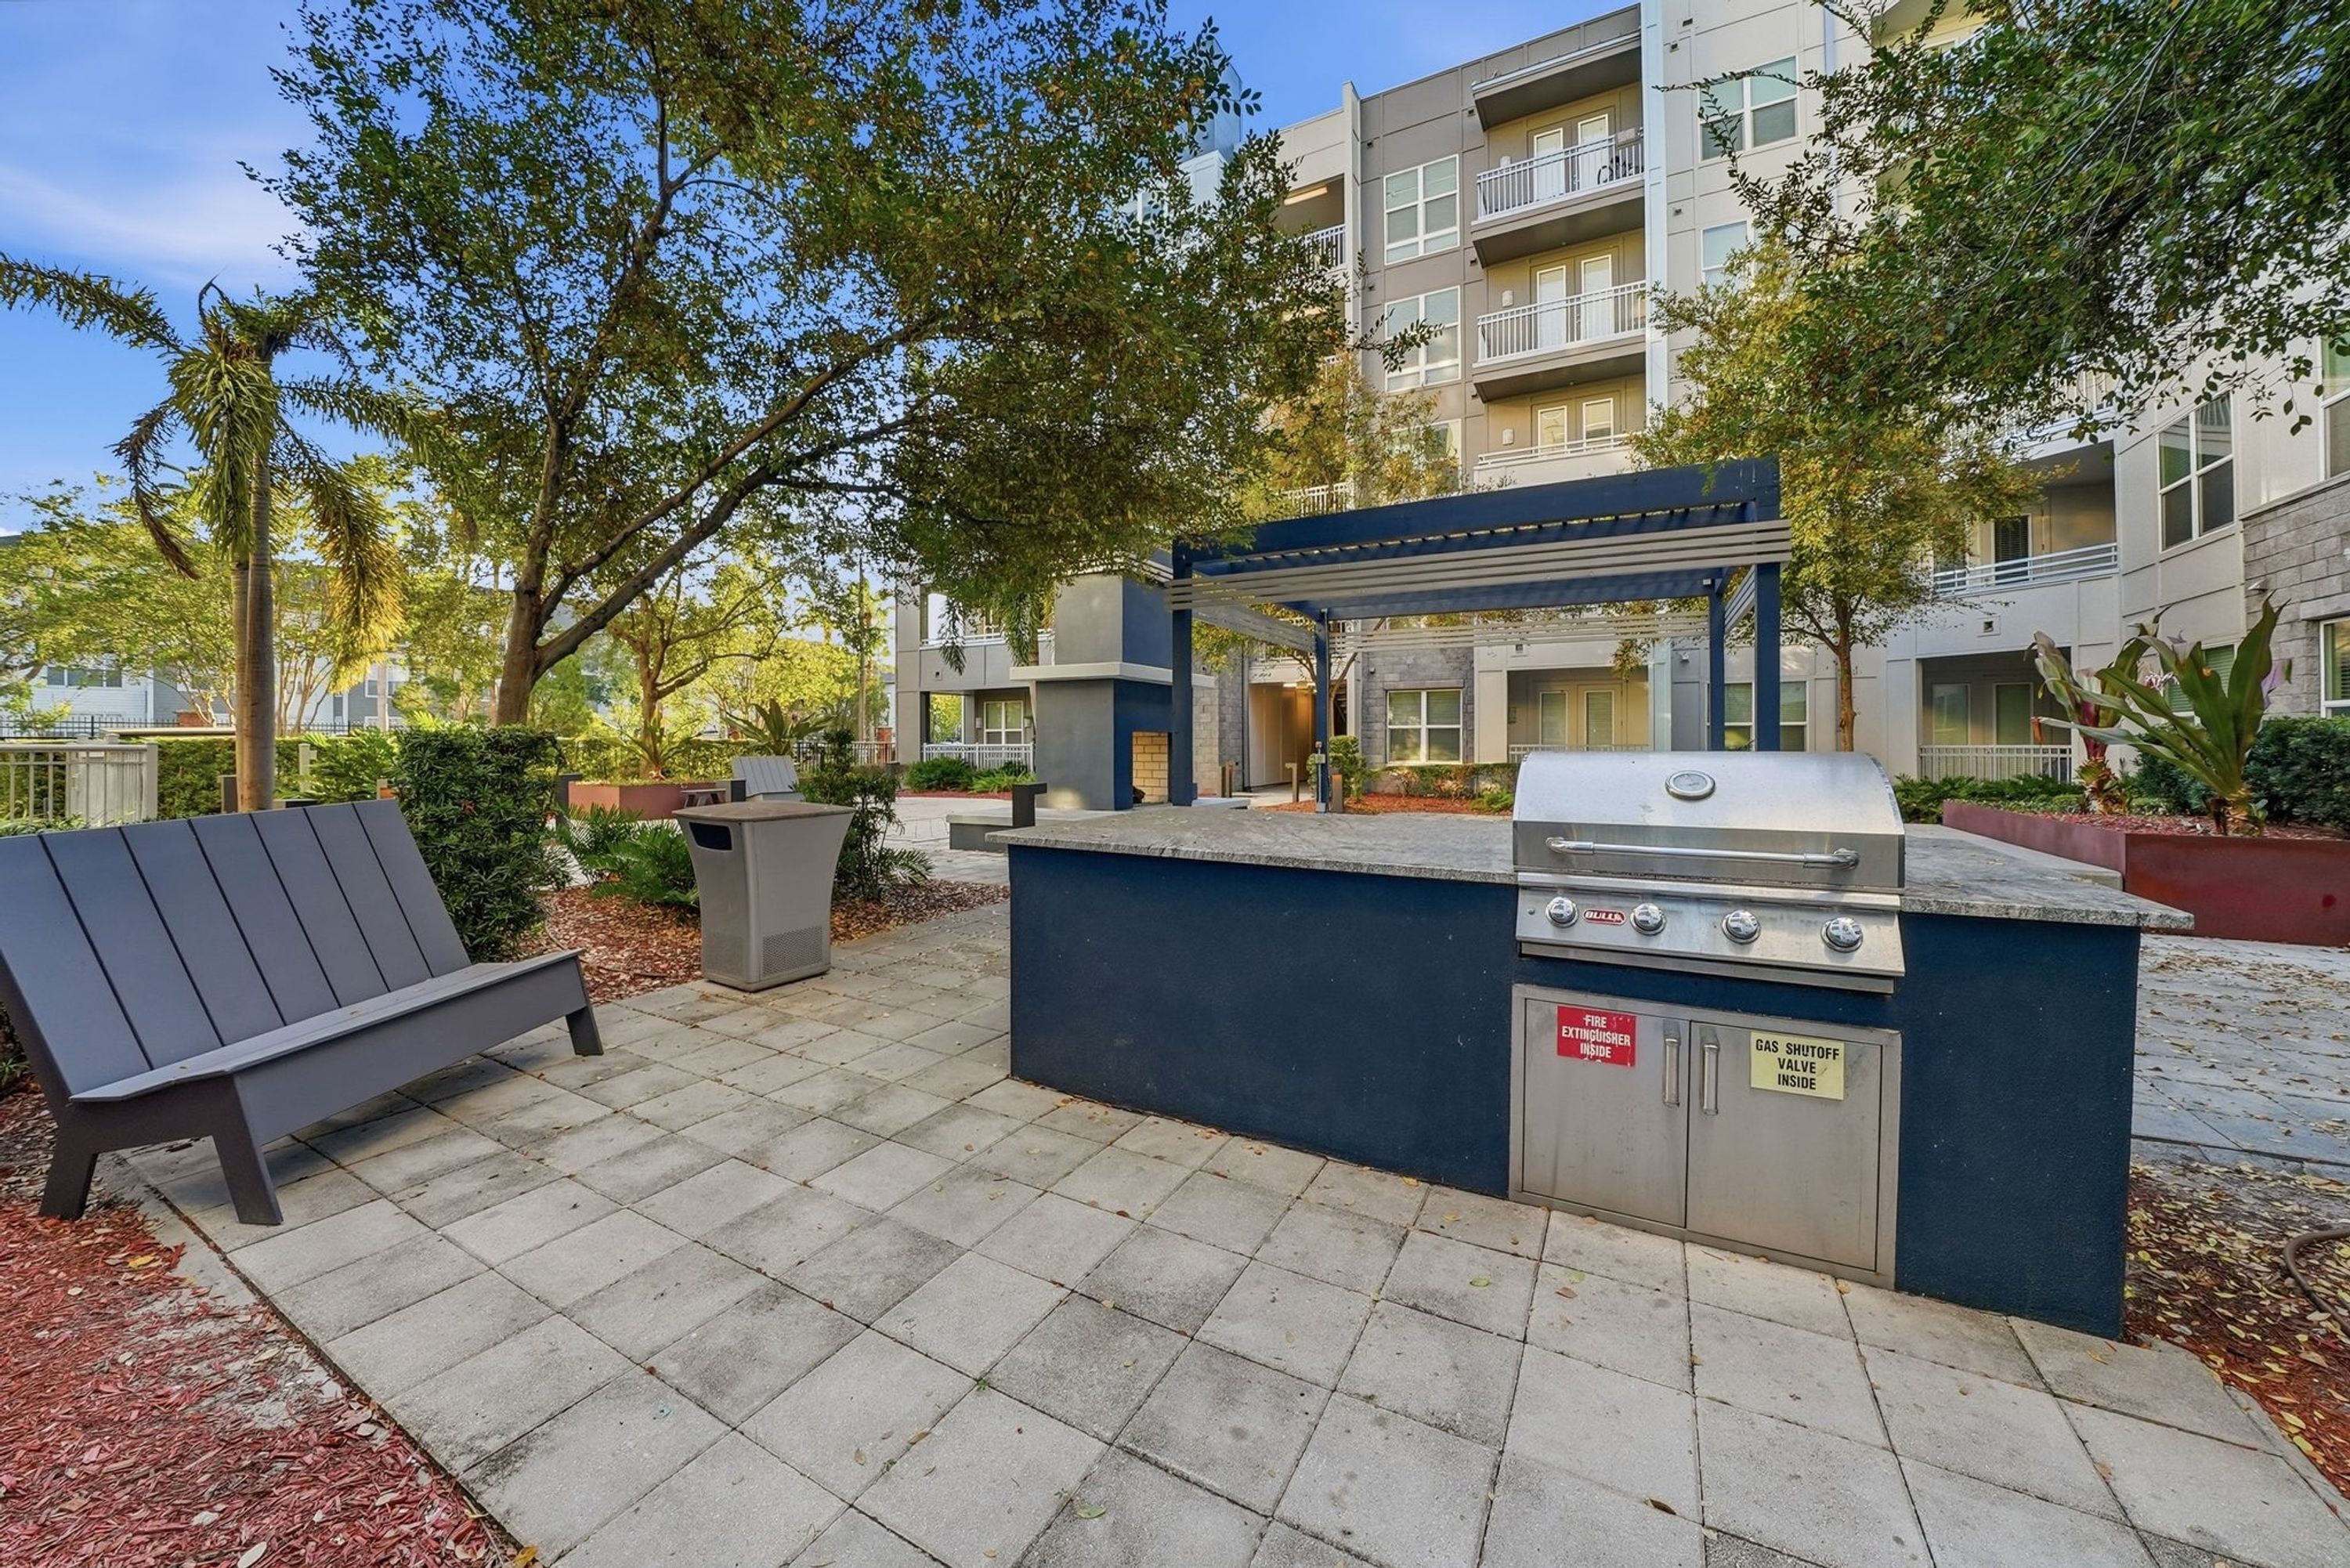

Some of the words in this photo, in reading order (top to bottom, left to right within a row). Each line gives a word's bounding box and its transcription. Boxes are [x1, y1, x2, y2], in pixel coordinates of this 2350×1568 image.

[1585, 1014, 1607, 1028] FIRE
[1561, 1026, 1631, 1046] EXTINGUISHER
[1580, 1042, 1612, 1058] INSIDE
[1755, 1039, 1779, 1053] GAS
[1786, 1042, 1839, 1060] SHUTOFF
[1777, 1057, 1816, 1074] VALVE
[1777, 1073, 1816, 1090] INSIDE
